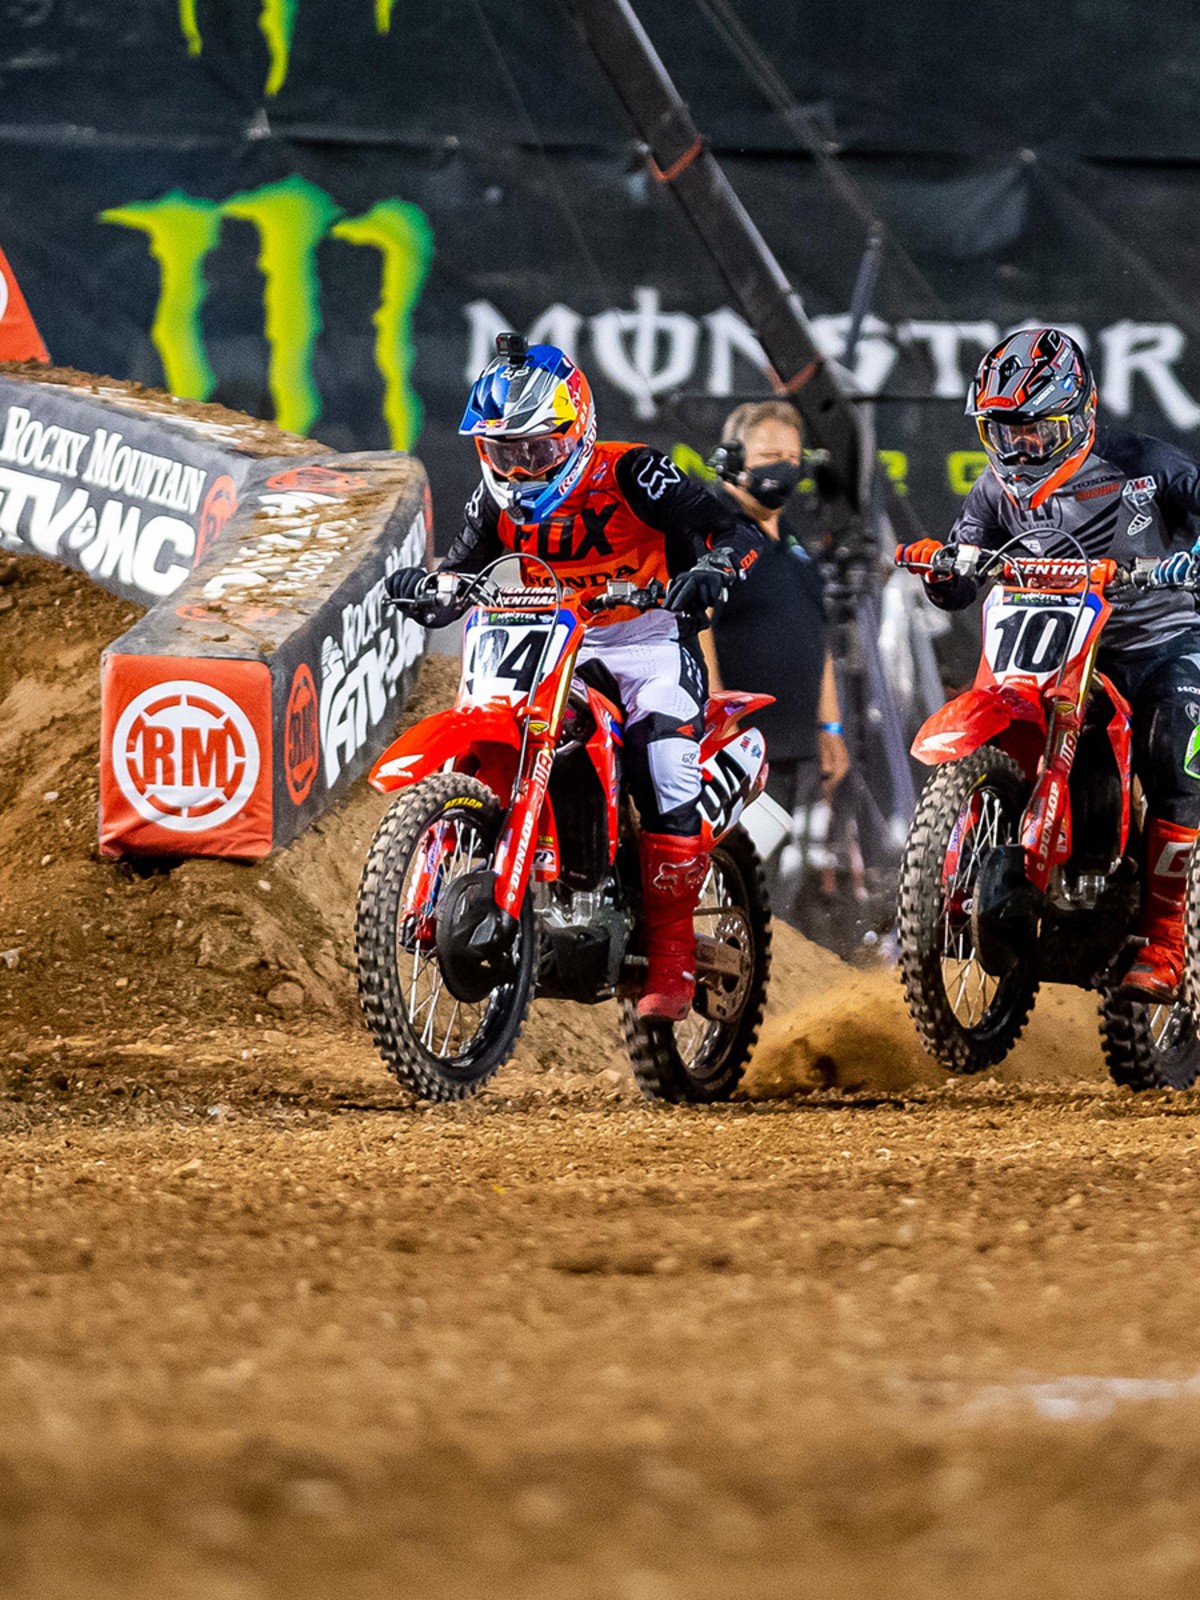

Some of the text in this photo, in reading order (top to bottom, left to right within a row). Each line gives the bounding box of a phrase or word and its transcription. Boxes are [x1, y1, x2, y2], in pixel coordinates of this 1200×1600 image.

[2, 405, 208, 515] ROCKY MOUNTAIN
[1127, 478, 1154, 492] AMA
[512, 502, 620, 562] FOX
[992, 609, 1078, 674] 10
[142, 724, 228, 788] RM
[510, 809, 534, 888] DUNLOP
[1038, 781, 1060, 859] DUNLOP
